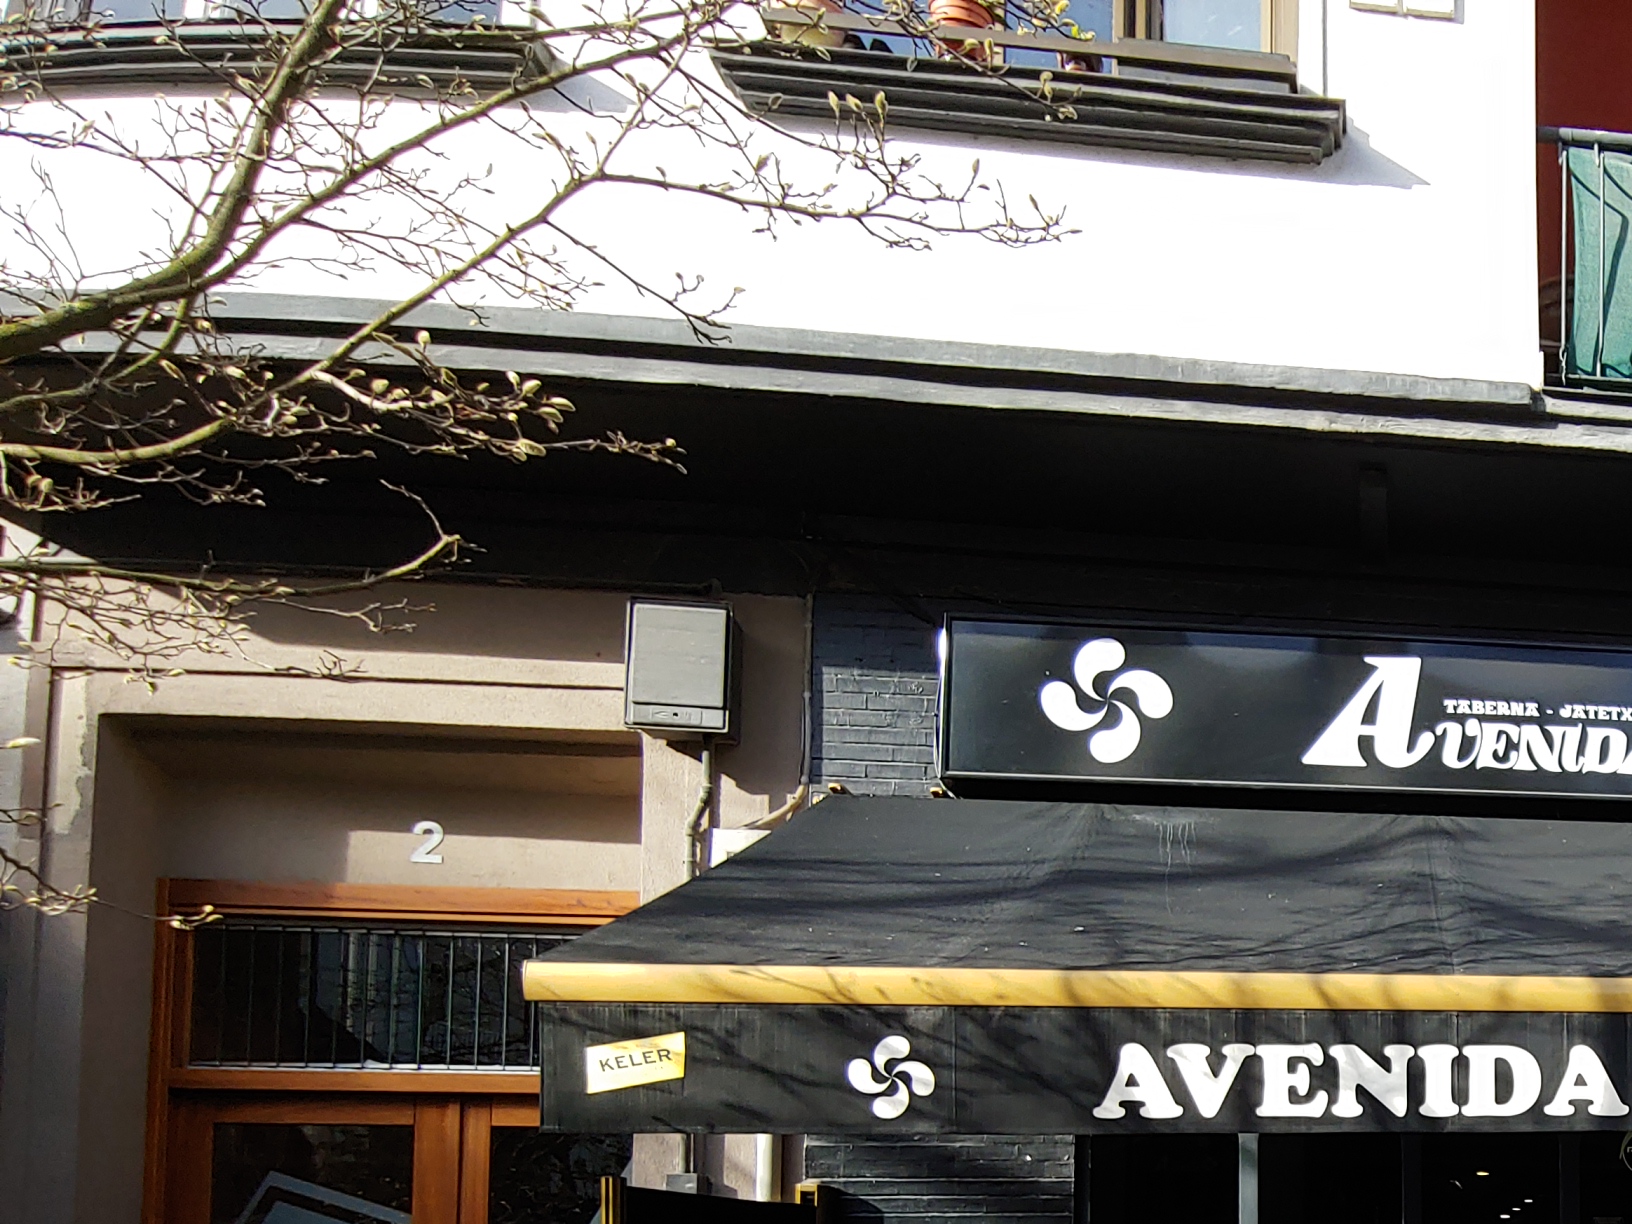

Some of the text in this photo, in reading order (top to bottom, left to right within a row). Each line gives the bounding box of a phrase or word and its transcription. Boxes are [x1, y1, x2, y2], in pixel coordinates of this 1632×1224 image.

[1443, 699, 1540, 717] TABERNA
[410, 820, 445, 865] 2
[599, 1048, 672, 1073] KELER
[1093, 1042, 1630, 1119] AVENIDA
